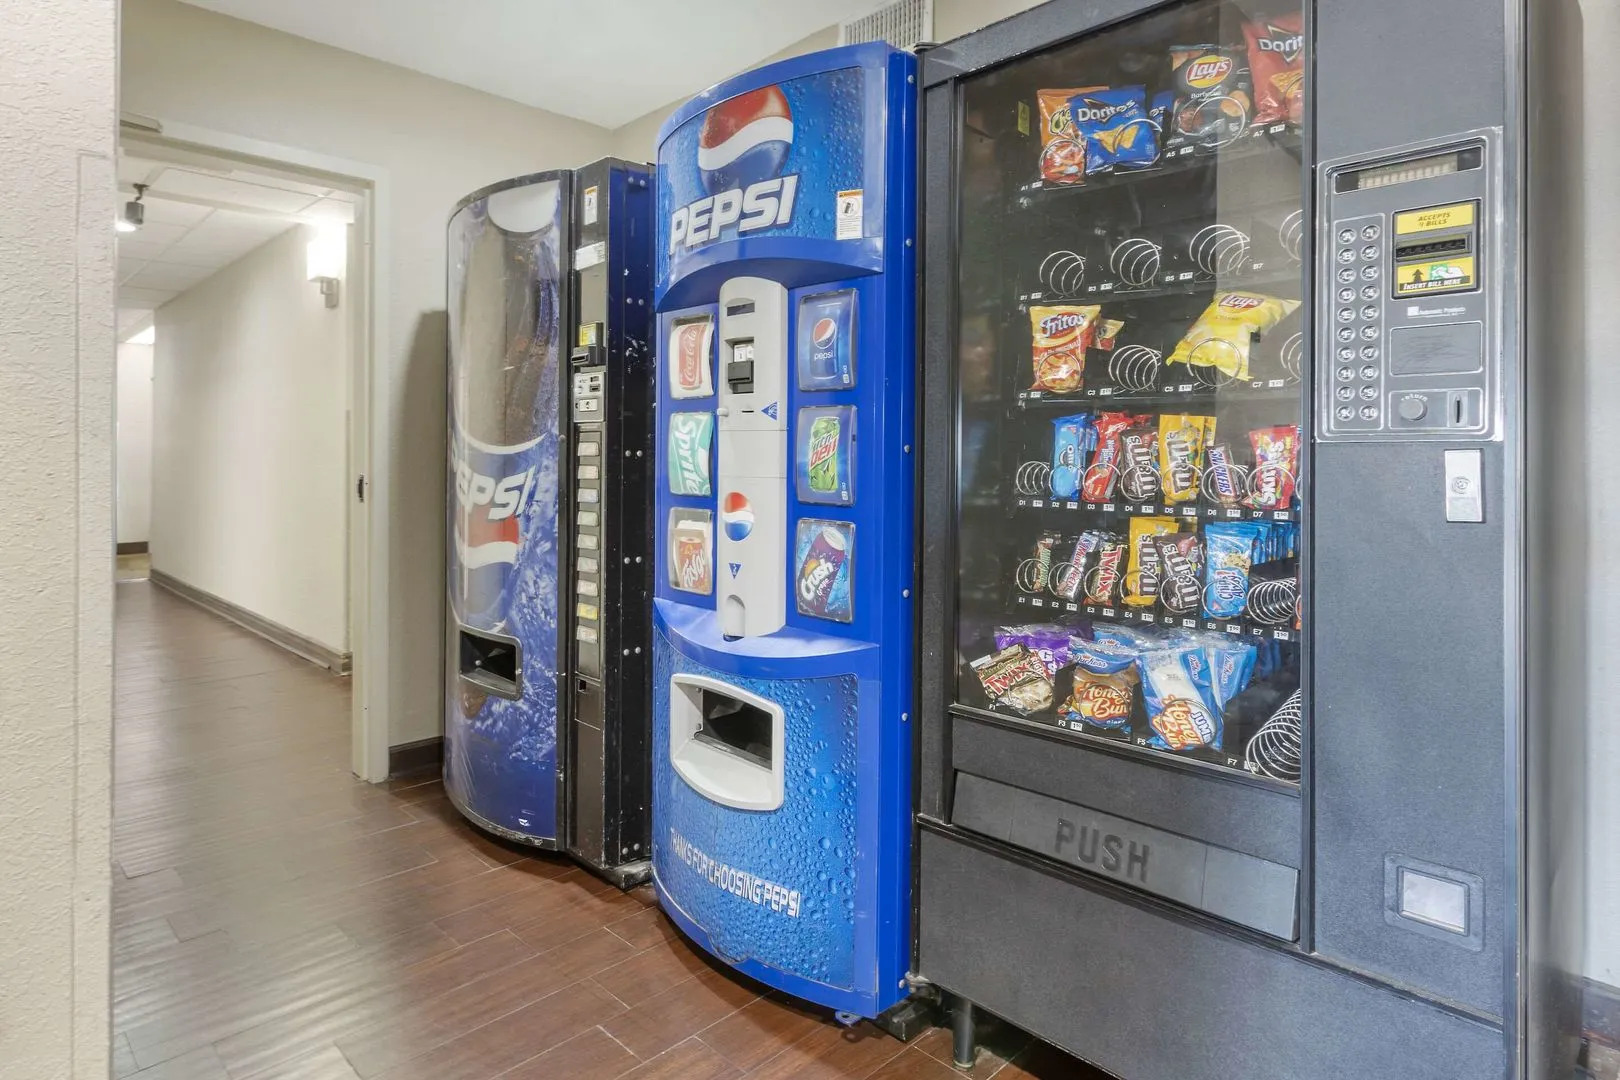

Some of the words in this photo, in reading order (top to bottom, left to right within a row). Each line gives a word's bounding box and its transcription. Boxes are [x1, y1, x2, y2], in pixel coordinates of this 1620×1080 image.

[1258, 35, 1303, 52] Dorit
[1078, 99, 1136, 122] Doritos
[670, 175, 798, 254] PEPSI
[1418, 211, 1451, 221] ACCEPTS
[1426, 219, 1447, 227] BILLS
[1403, 282, 1427, 290] INSERT
[1040, 314, 1085, 337] Fritos
[814, 350, 834, 363] pepsi
[675, 416, 702, 495] Sprite
[1209, 449, 1233, 496] SNICKERS
[801, 558, 834, 601] Crush
[1097, 547, 1121, 597] Twix
[1253, 628, 1263, 636] E7
[984, 662, 1029, 696] Twix
[1081, 682, 1129, 705] Honey
[1092, 697, 1128, 719] Bun
[1054, 817, 1150, 883] PUSH
[670, 827, 693, 866] THANKS
[692, 848, 708, 879] FOR
[708, 858, 763, 906] CHOOSING
[762, 882, 801, 918] PEPSI
